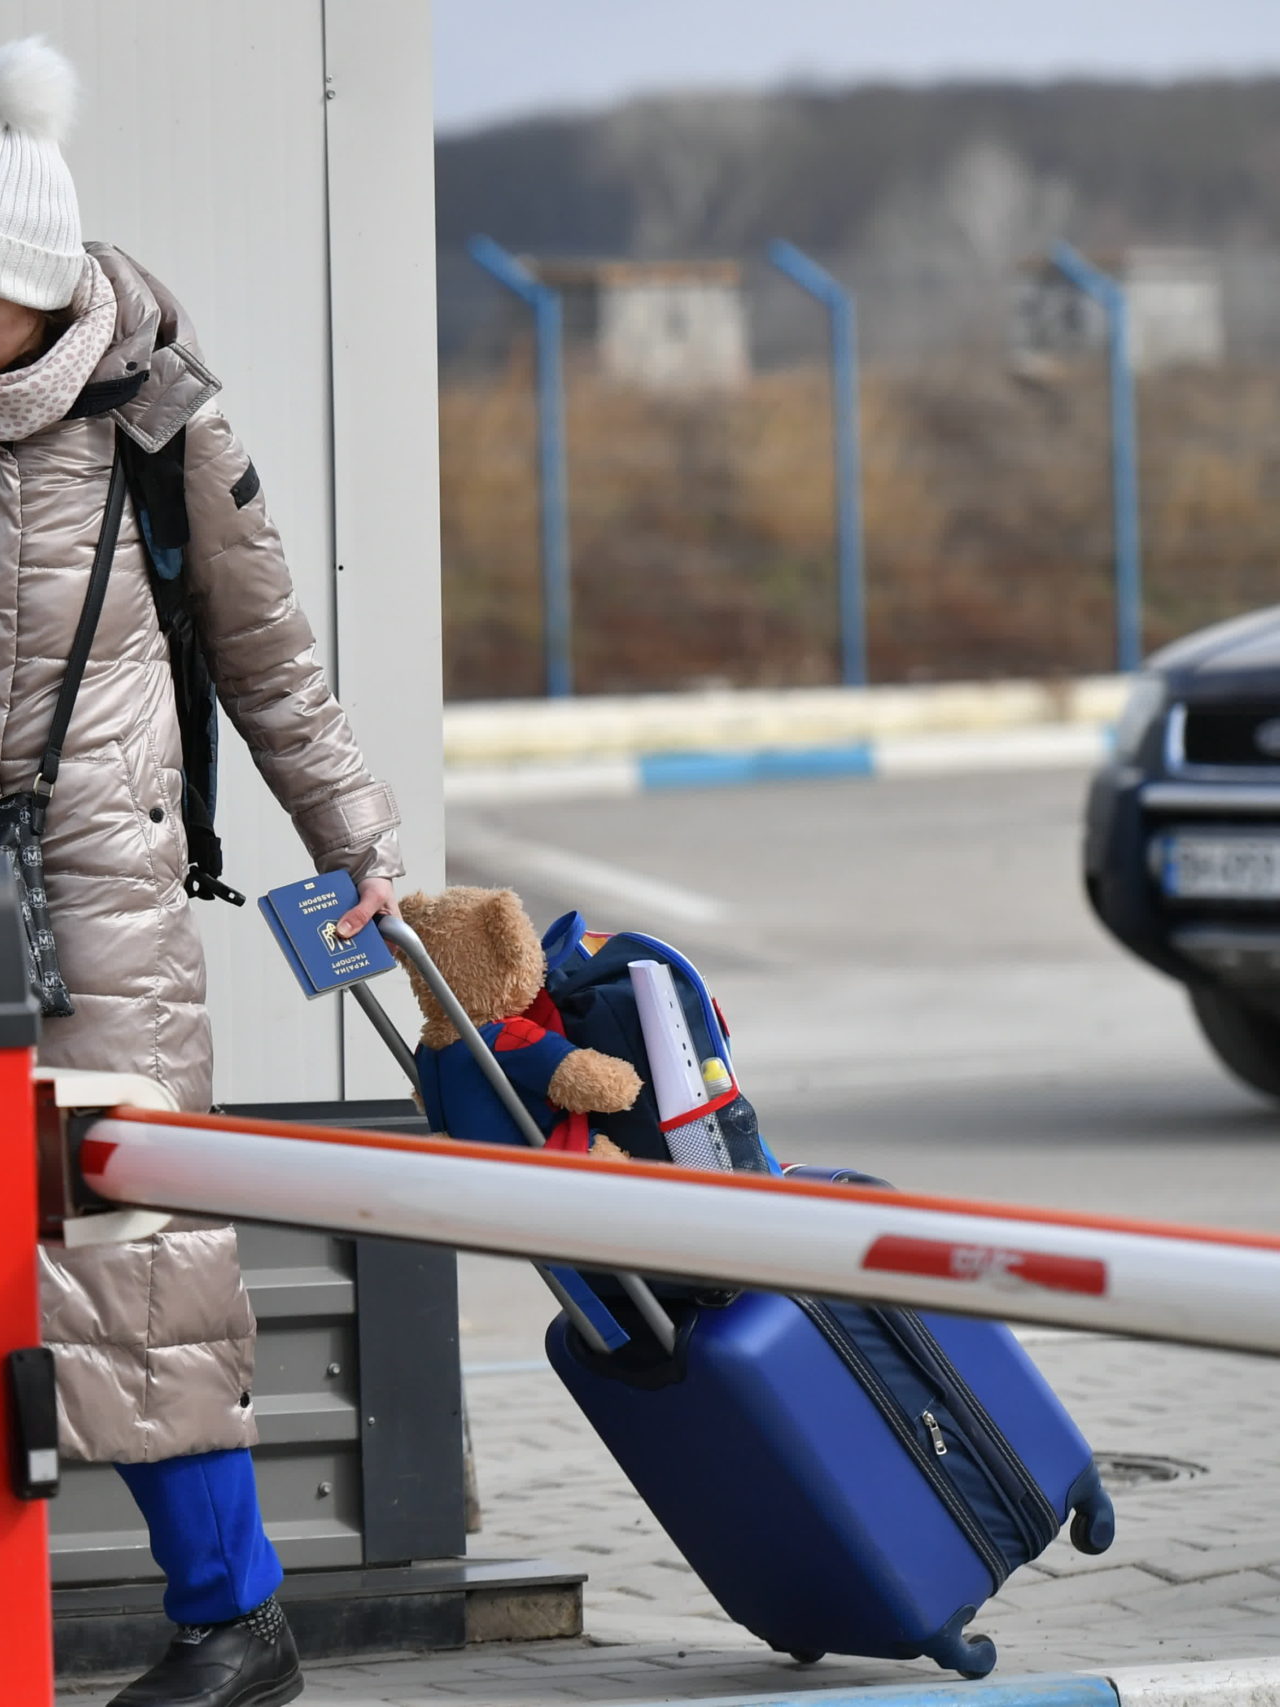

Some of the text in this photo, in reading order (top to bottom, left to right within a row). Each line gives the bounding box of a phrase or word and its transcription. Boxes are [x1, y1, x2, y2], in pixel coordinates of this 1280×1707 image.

[298, 891, 336, 908] PASSPORT
[303, 899, 338, 914] UKRAINE
[331, 952, 367, 969] ПАСПОРТ
[335, 960, 370, 976] УКРАЇНА
